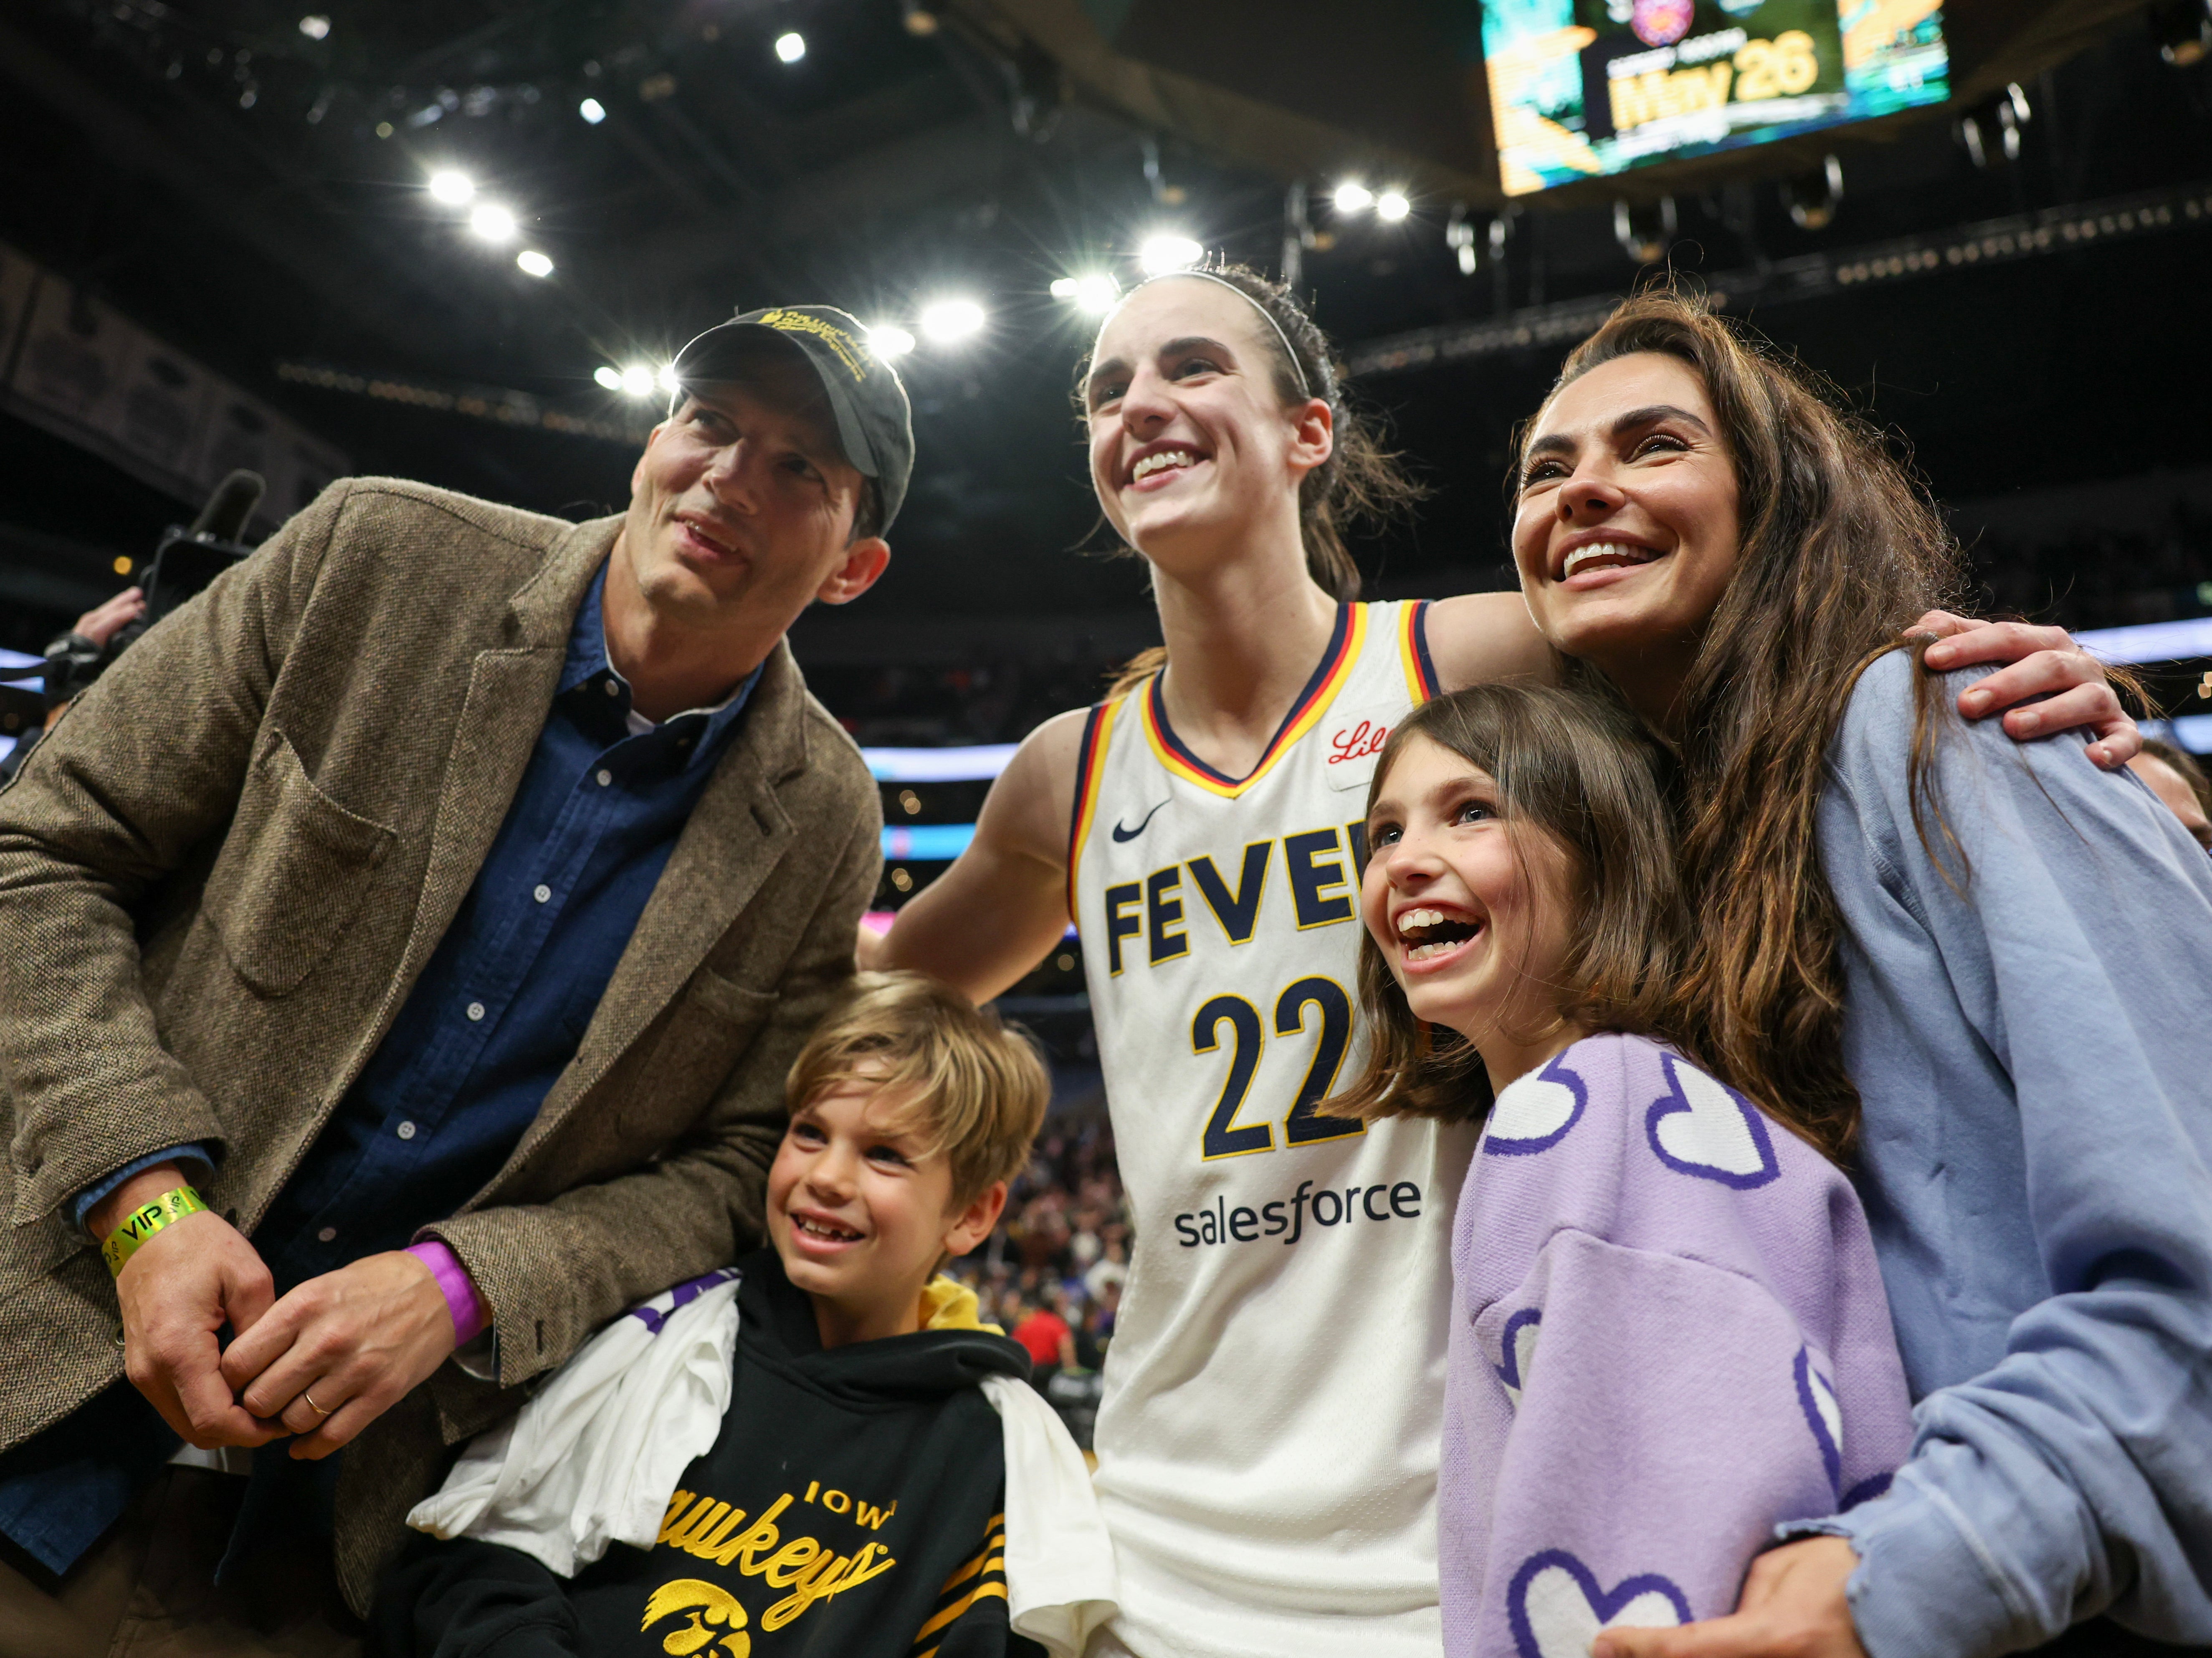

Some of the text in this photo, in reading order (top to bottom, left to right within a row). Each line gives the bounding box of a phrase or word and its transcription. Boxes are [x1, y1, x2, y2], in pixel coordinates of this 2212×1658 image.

[1733, 29, 1819, 101] 26
[1329, 720, 1395, 764] Lil
[1191, 975, 1367, 1161] 22
[121, 1206, 162, 1240] VIP
[167, 1196, 180, 1215] VIP
[1174, 1180, 1422, 1245] salesforce
[804, 1481, 898, 1530] IOW
